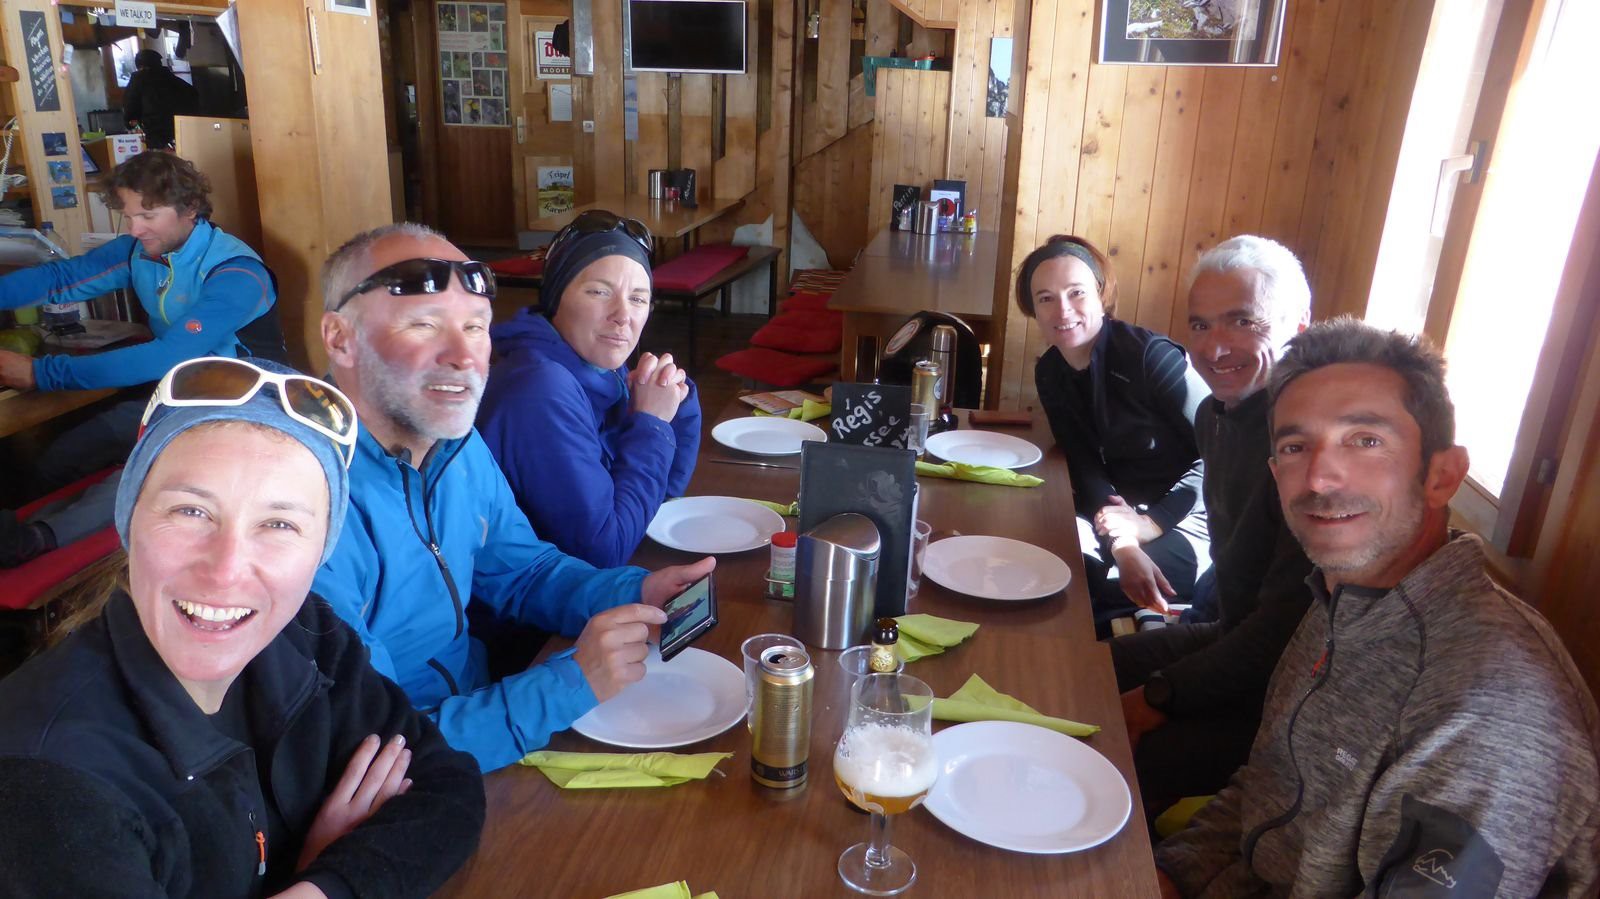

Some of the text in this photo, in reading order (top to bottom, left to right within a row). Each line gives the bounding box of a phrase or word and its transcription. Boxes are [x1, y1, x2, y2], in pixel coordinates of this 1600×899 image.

[119, 8, 153, 20] WE TALK TO
[832, 390, 882, 440] Régis
